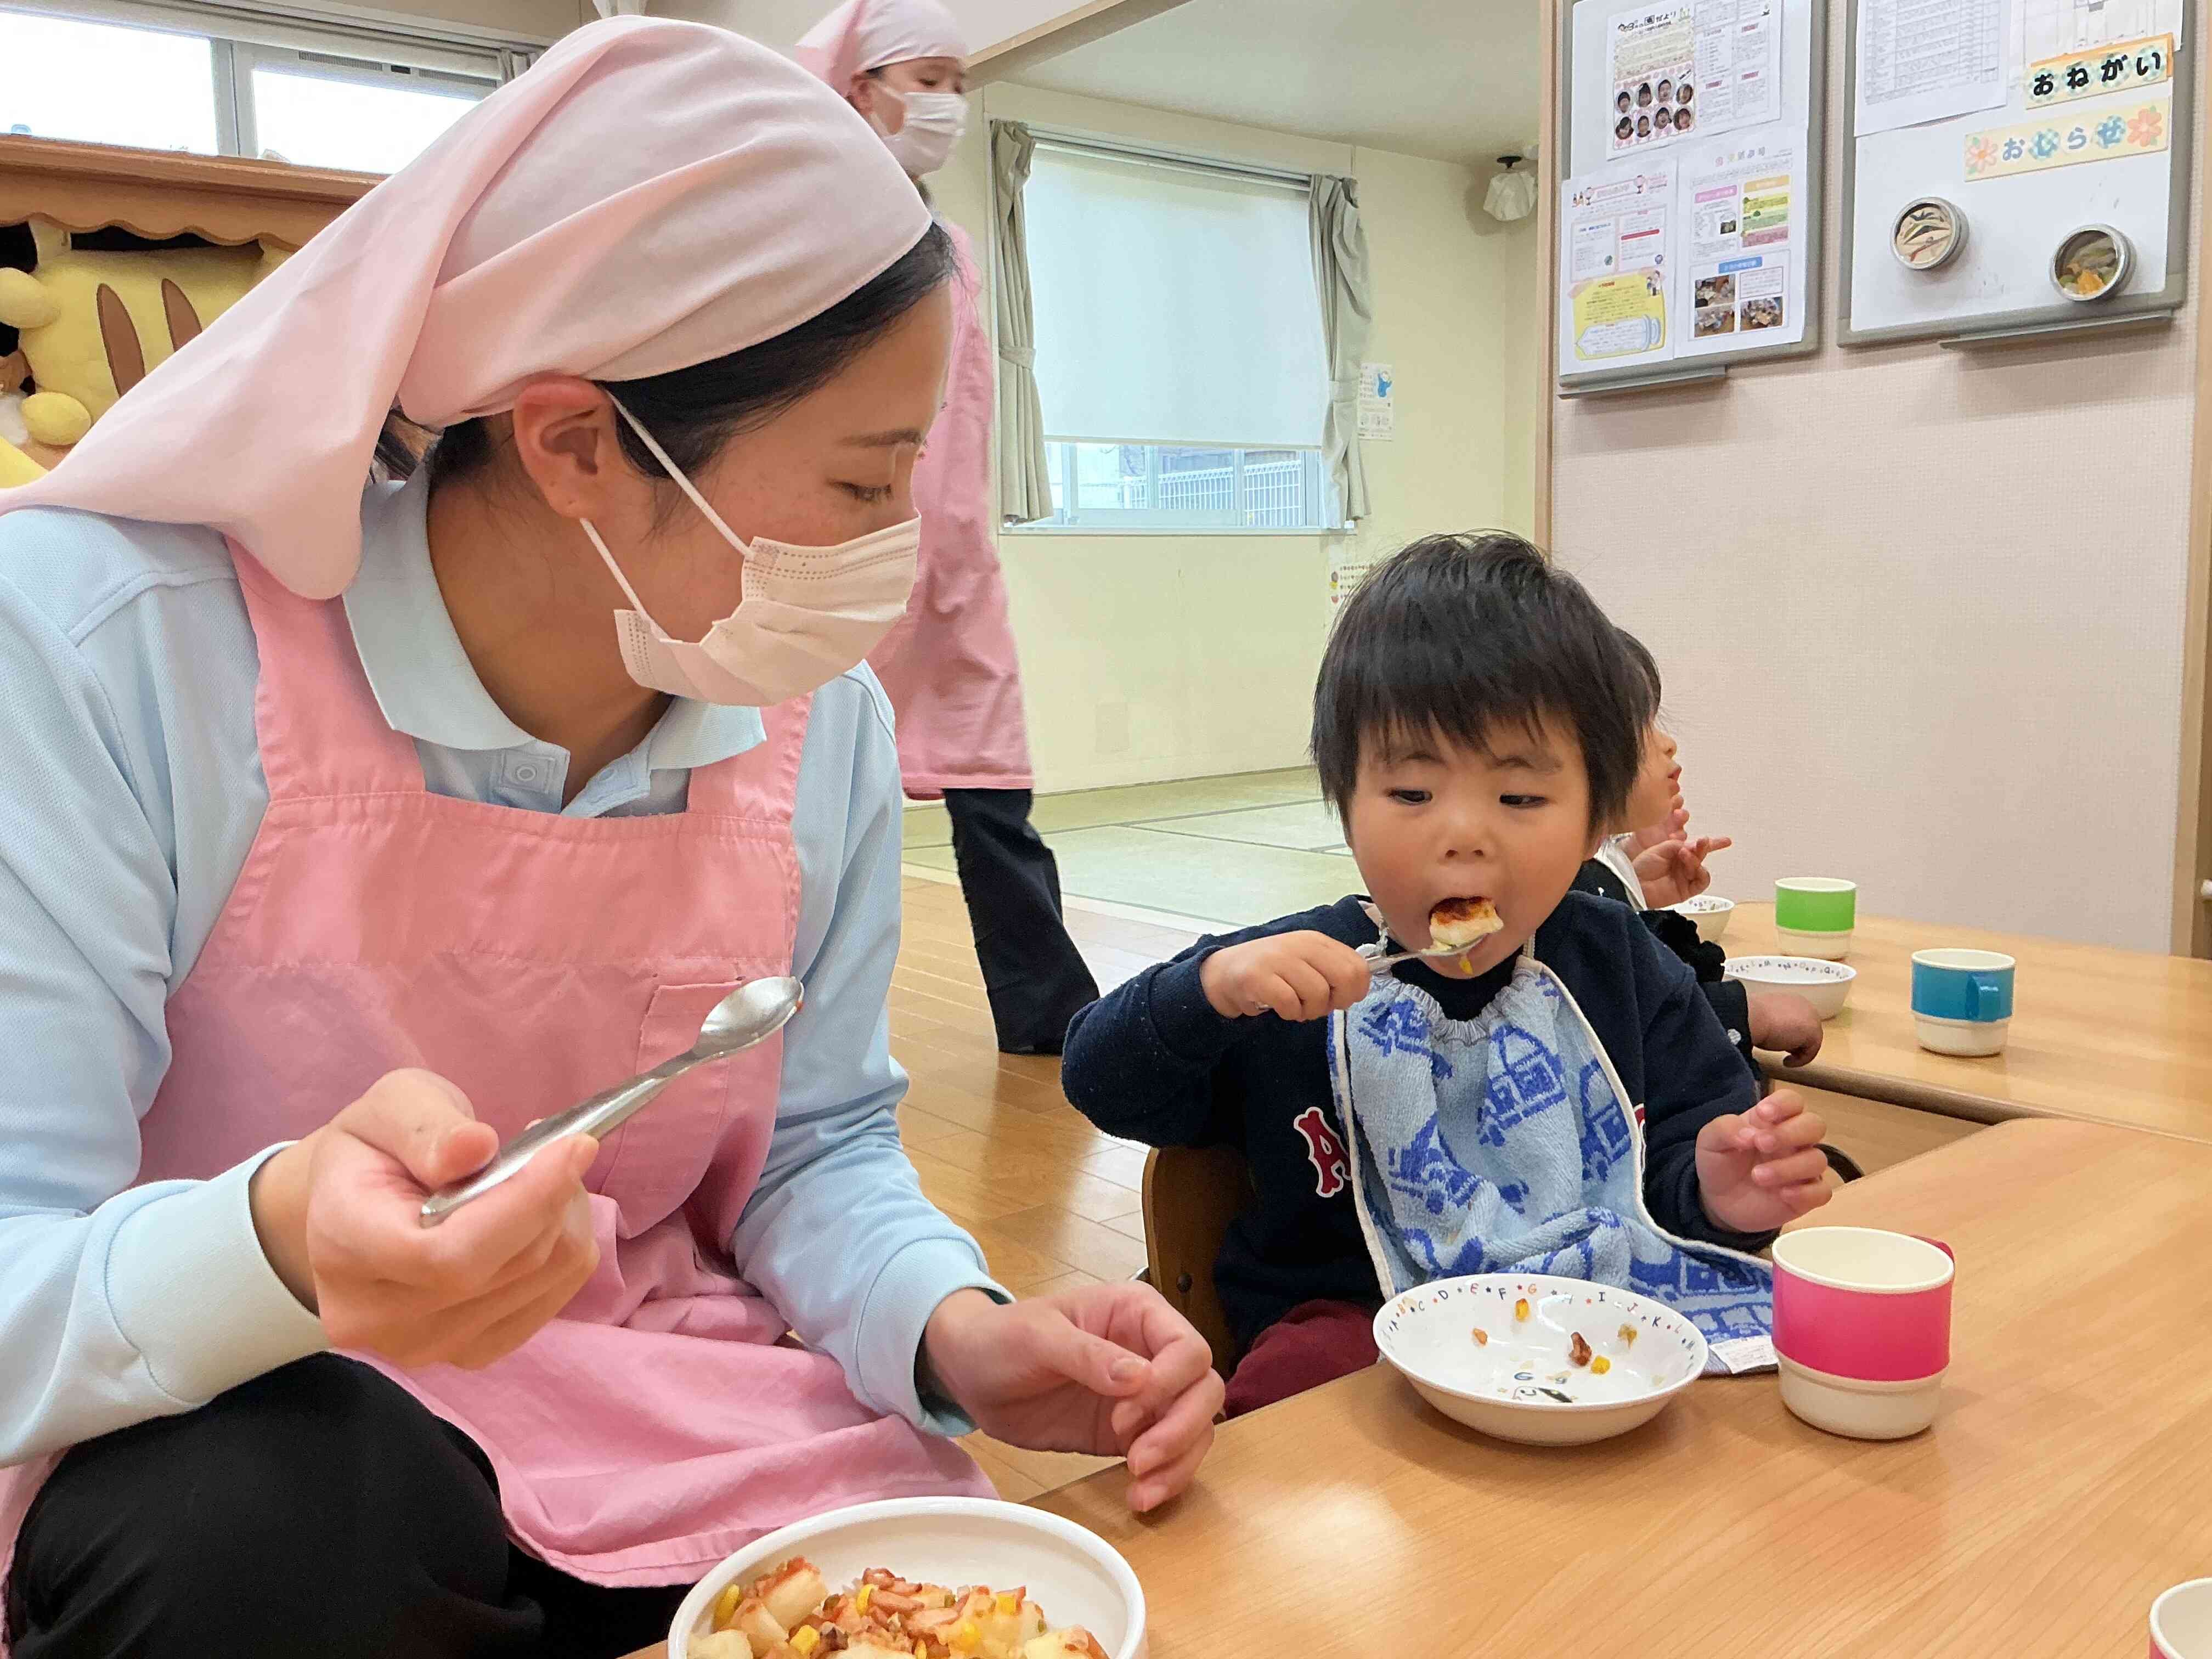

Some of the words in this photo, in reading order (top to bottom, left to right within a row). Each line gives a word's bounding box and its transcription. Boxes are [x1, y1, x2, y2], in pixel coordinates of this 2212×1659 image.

[2033, 52, 2160, 95] おねがい
[2002, 121, 2121, 161] おしらせ
[1419, 1301, 1425, 1311] C
[1438, 1290, 1448, 1300] D
[1470, 1283, 1479, 1294] E
[1498, 1288, 1506, 1300] F
[1528, 1284, 1537, 1295] G
[1599, 1292, 1605, 1301] I
[1627, 1302, 1638, 1312] J
[1652, 1317, 1661, 1327] K
